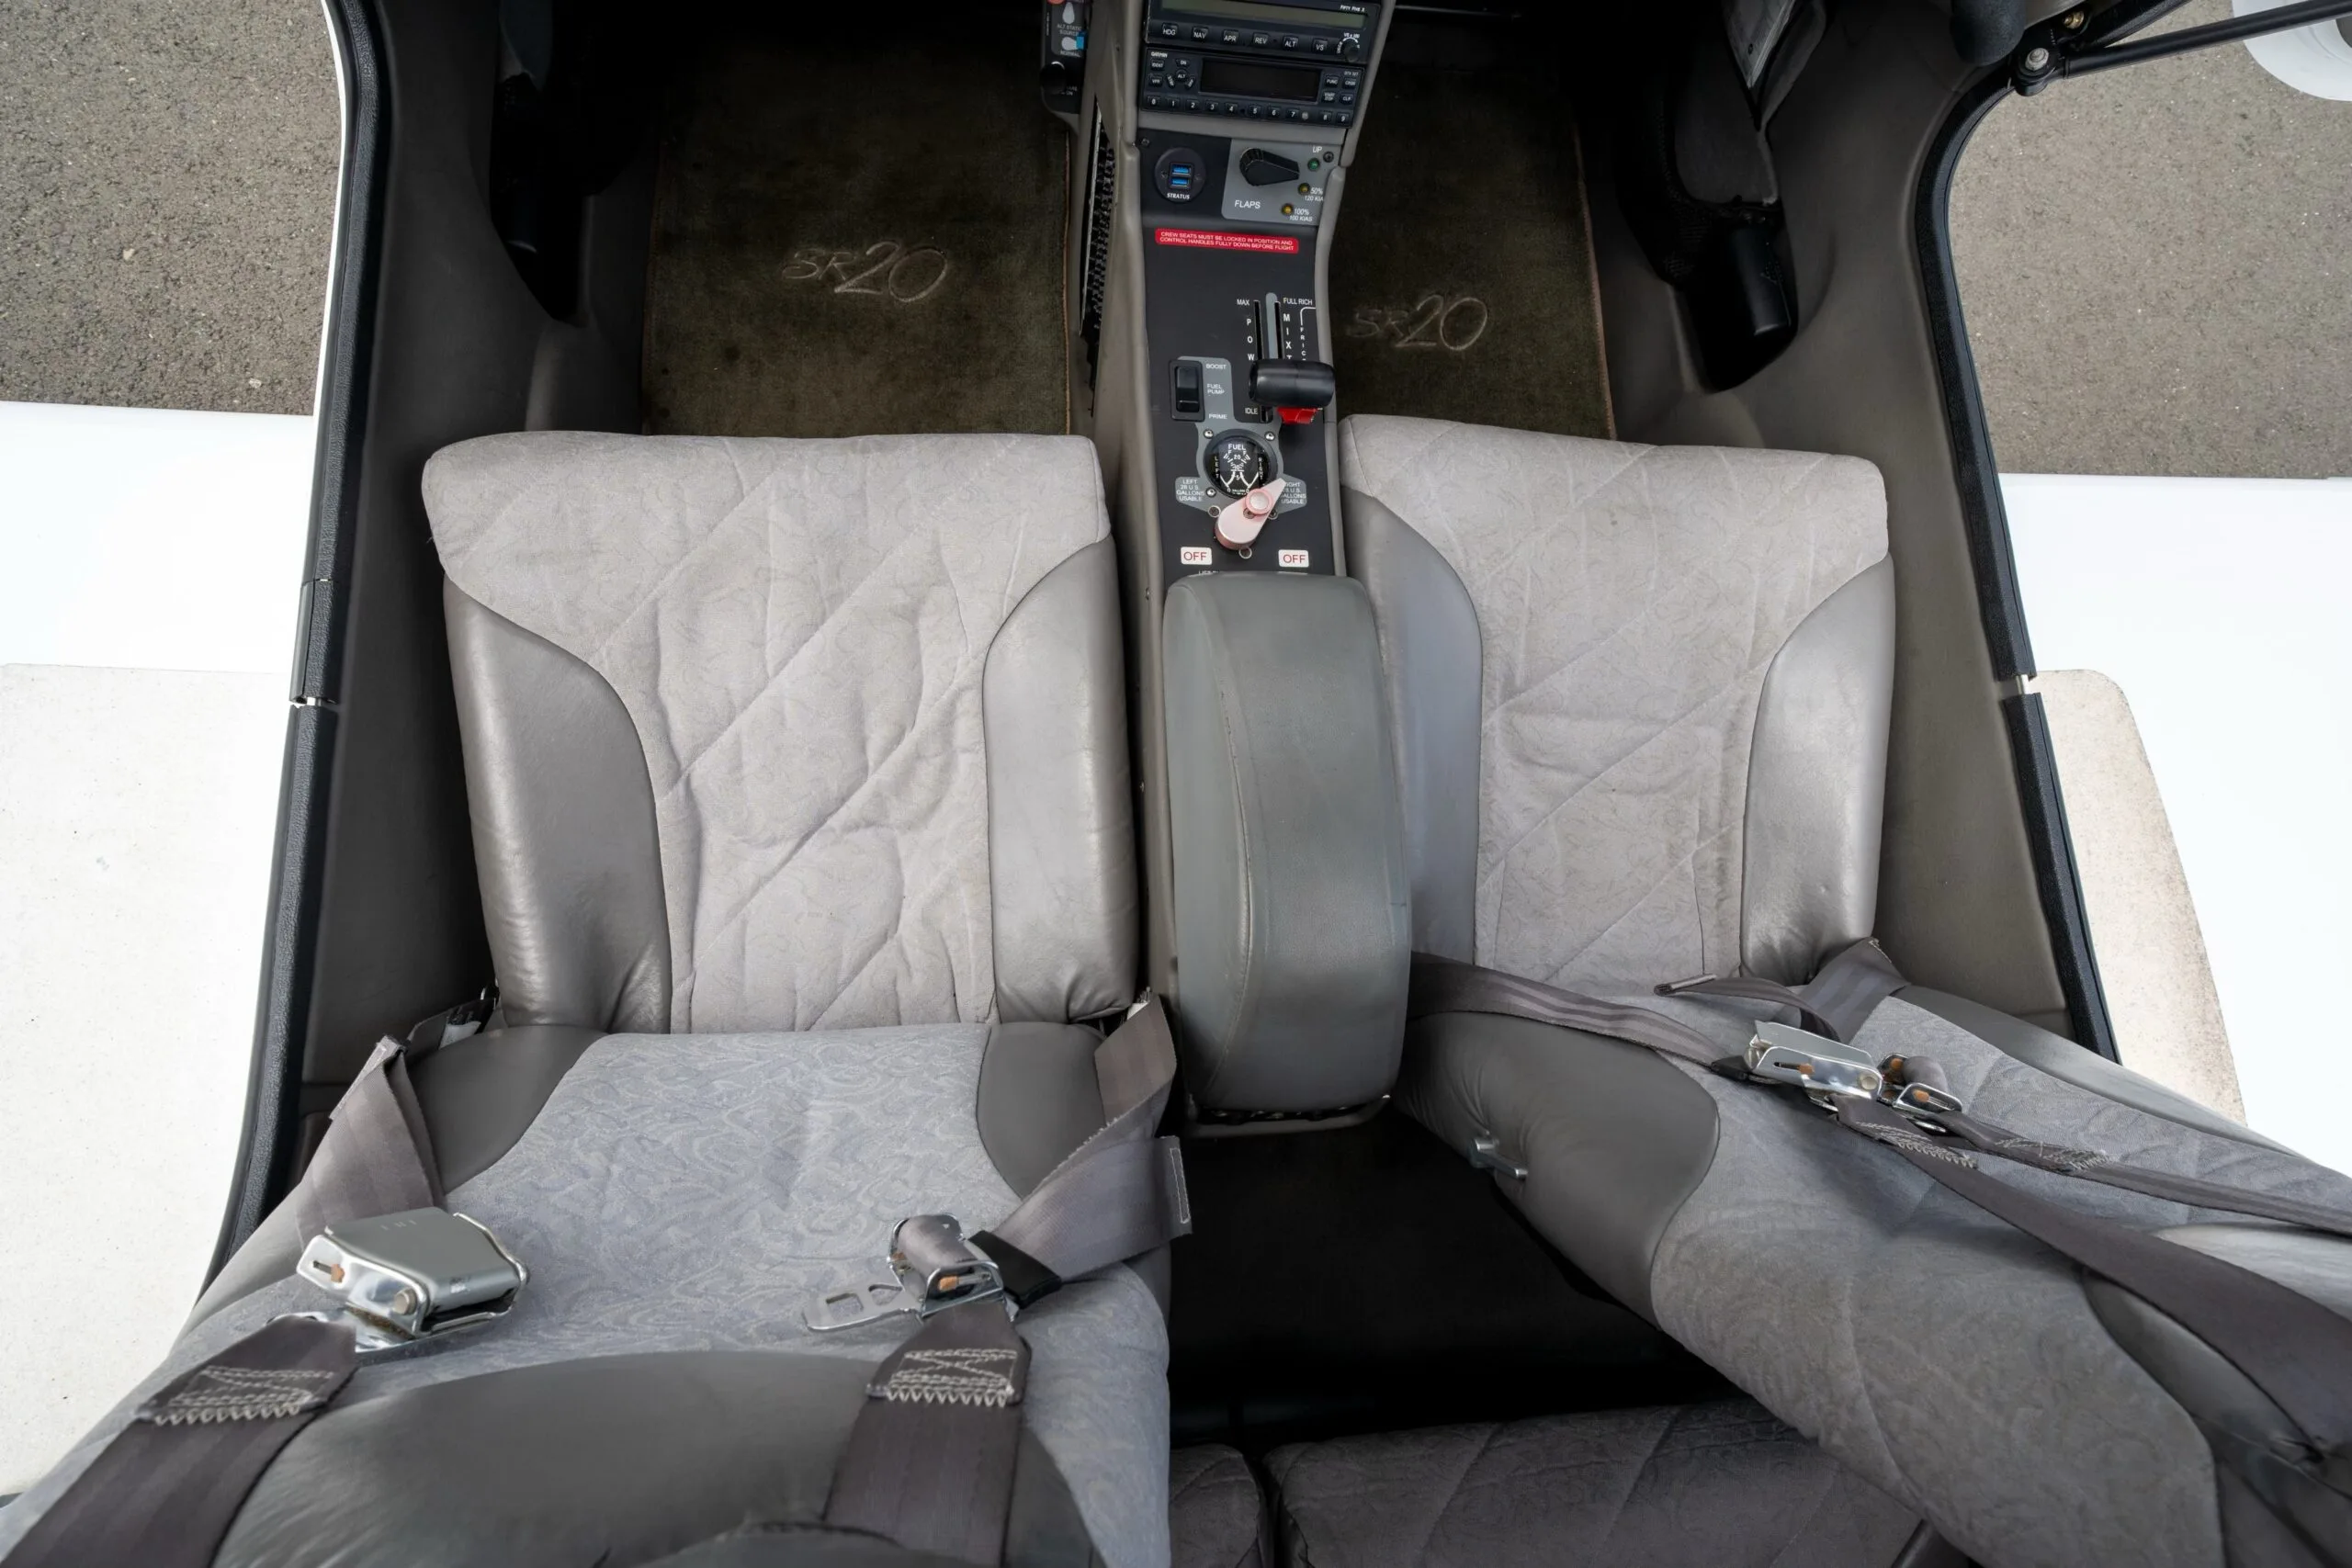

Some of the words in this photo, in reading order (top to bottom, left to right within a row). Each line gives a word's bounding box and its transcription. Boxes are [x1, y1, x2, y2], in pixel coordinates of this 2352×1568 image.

[1234, 200, 1261, 209] FLAPS
[782, 241, 948, 303] SR20
[1283, 297, 1297, 305] FULL
[1344, 294, 1488, 351] SR20
[1246, 318, 1255, 361] POW
[1283, 313, 1293, 360] MIXT
[1183, 551, 1207, 561] OFF
[1283, 554, 1306, 564] OFF
